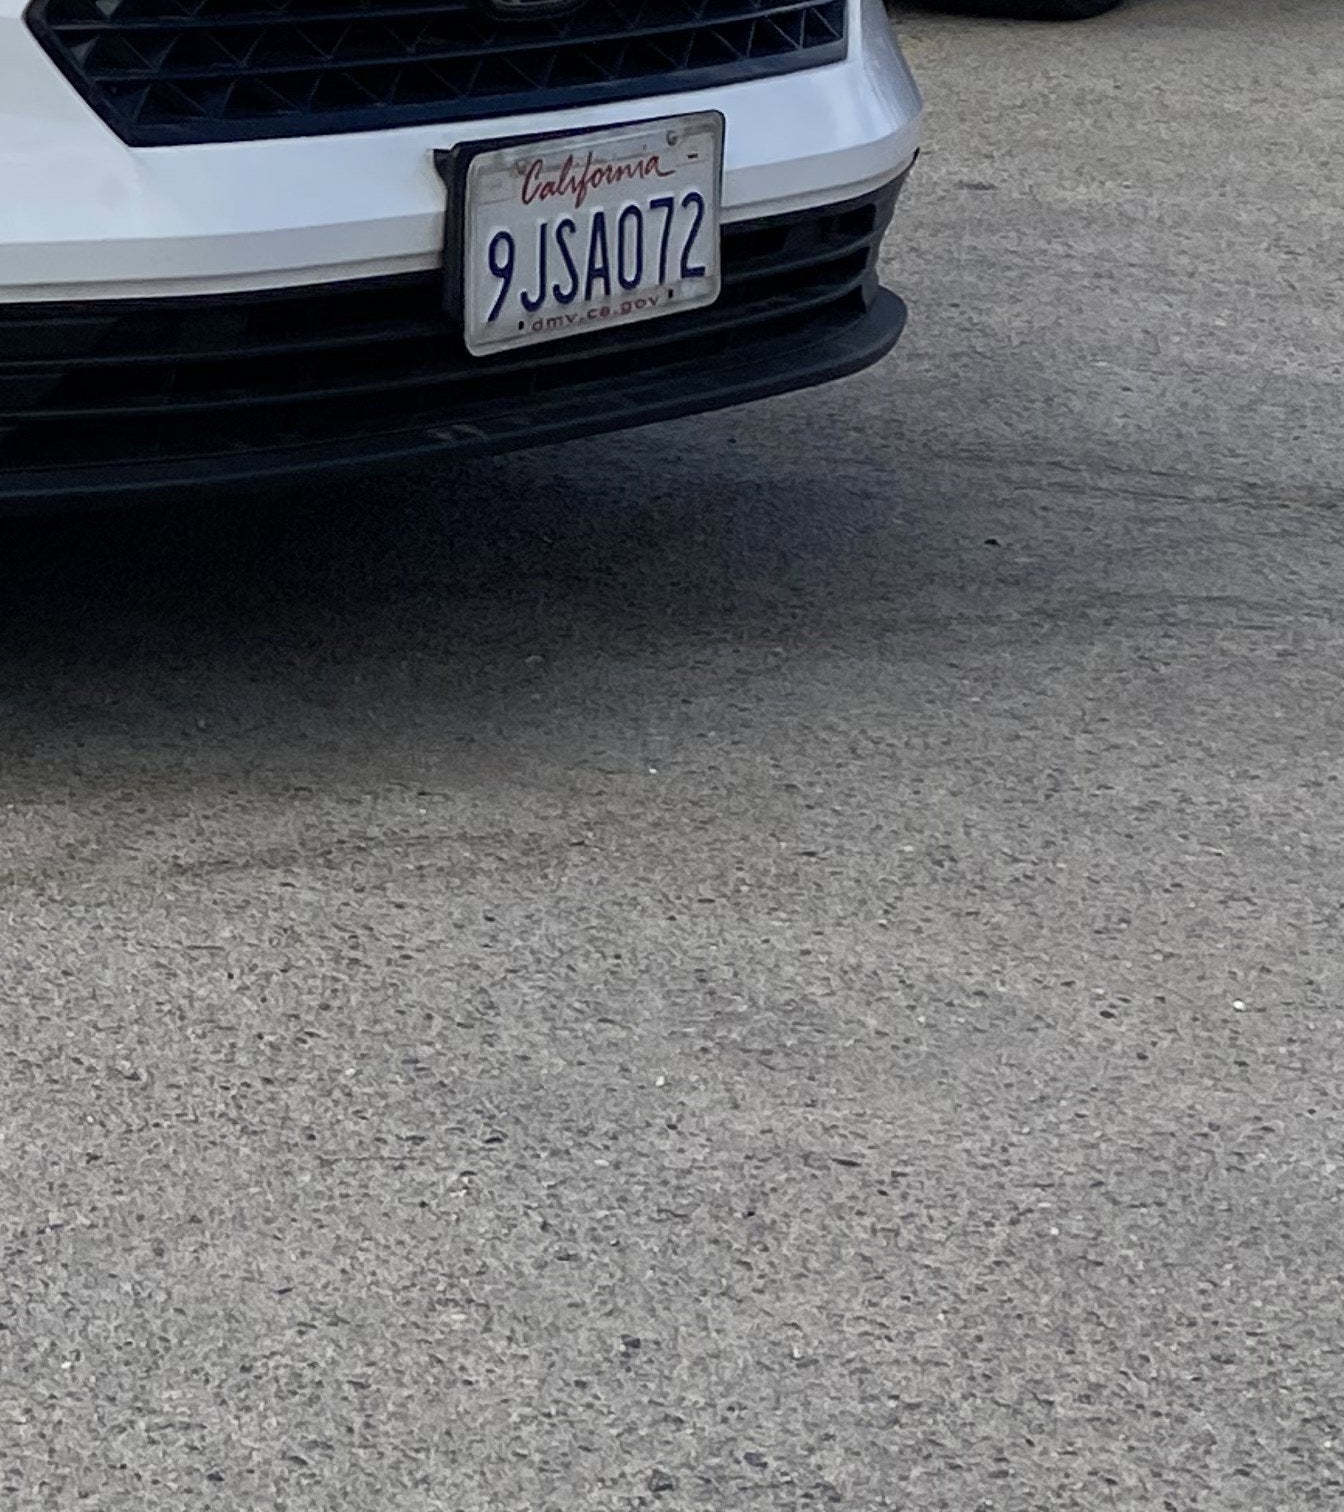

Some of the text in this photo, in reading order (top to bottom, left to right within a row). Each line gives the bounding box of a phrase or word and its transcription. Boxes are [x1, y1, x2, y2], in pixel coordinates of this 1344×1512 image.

[520, 145, 675, 209] California
[486, 191, 707, 324] 9JSA072
[531, 293, 660, 333] dmv.ca.gov
